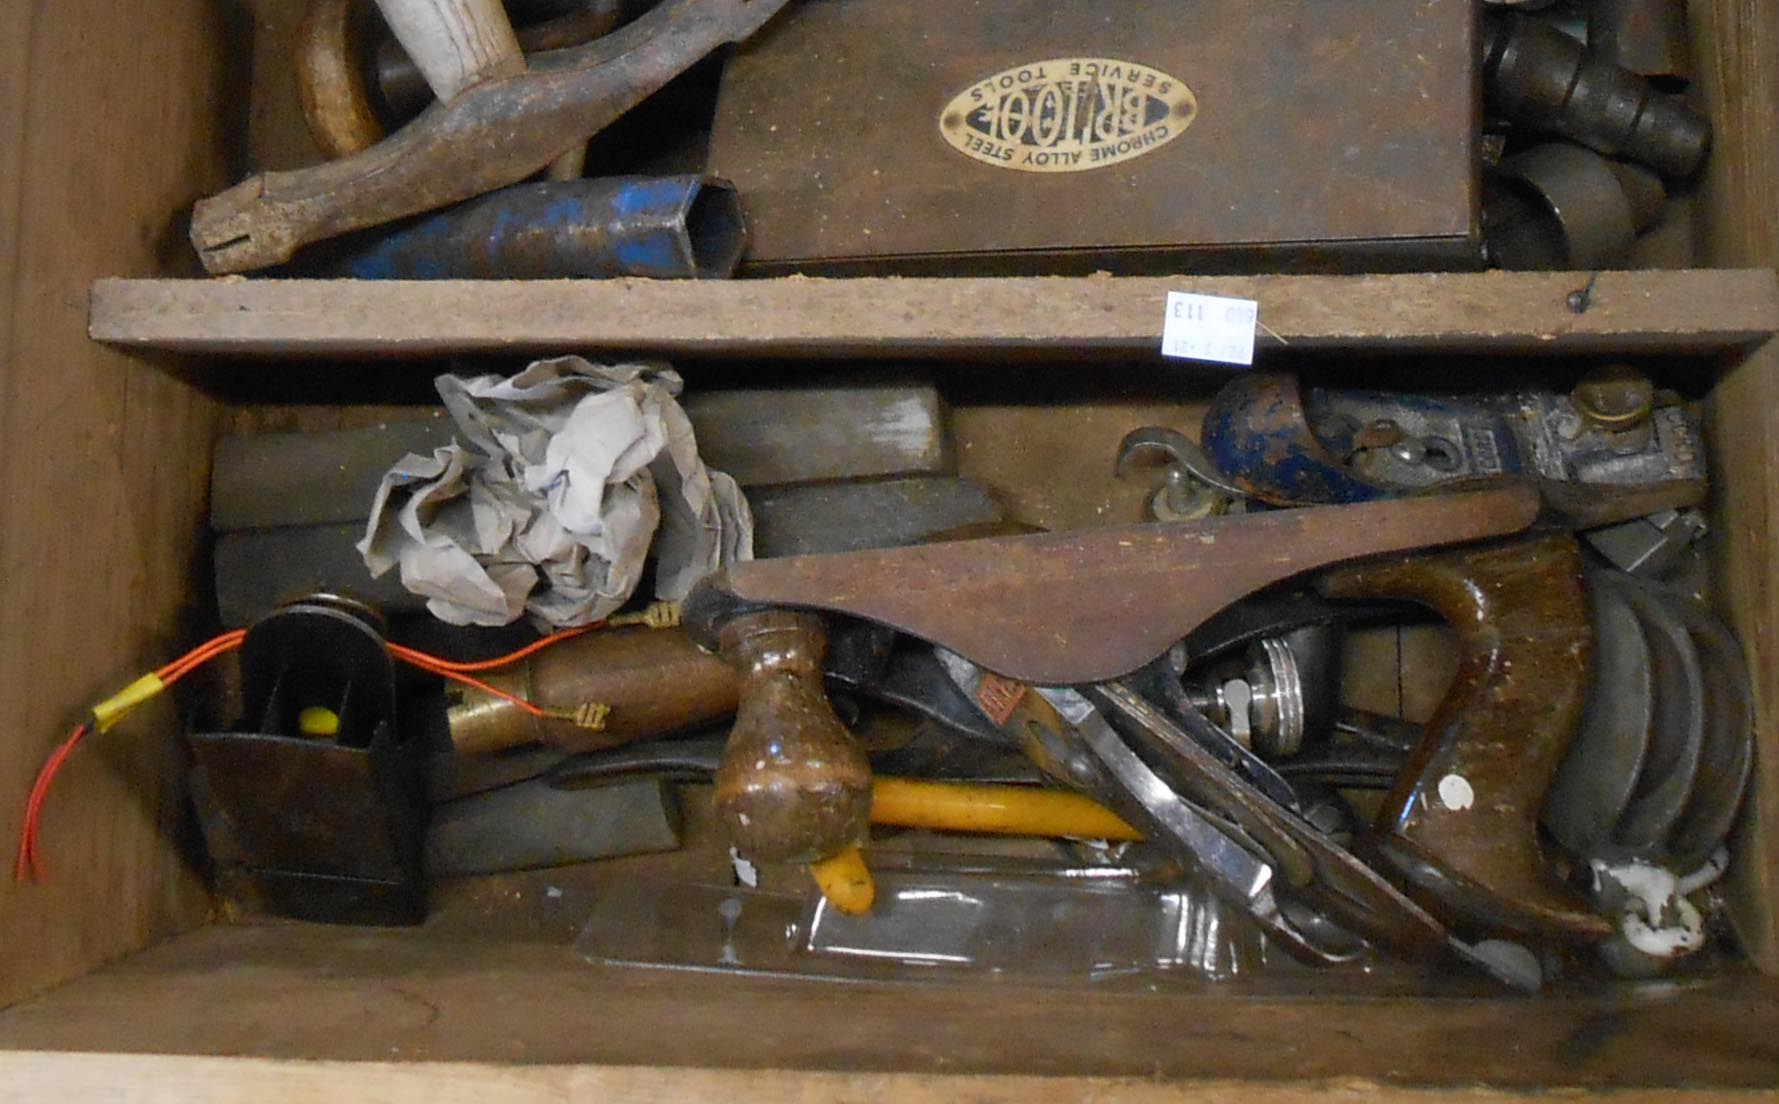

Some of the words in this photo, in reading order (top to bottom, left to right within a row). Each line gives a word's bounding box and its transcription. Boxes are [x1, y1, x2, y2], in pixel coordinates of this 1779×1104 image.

[970, 66, 1047, 102] TOOLS
[1070, 62, 1172, 94] SERVICE
[964, 132, 1015, 161] STEEL
[1022, 149, 1083, 166] ALLOY
[1090, 125, 1170, 162] CHROME
[1174, 301, 1203, 321] 113
